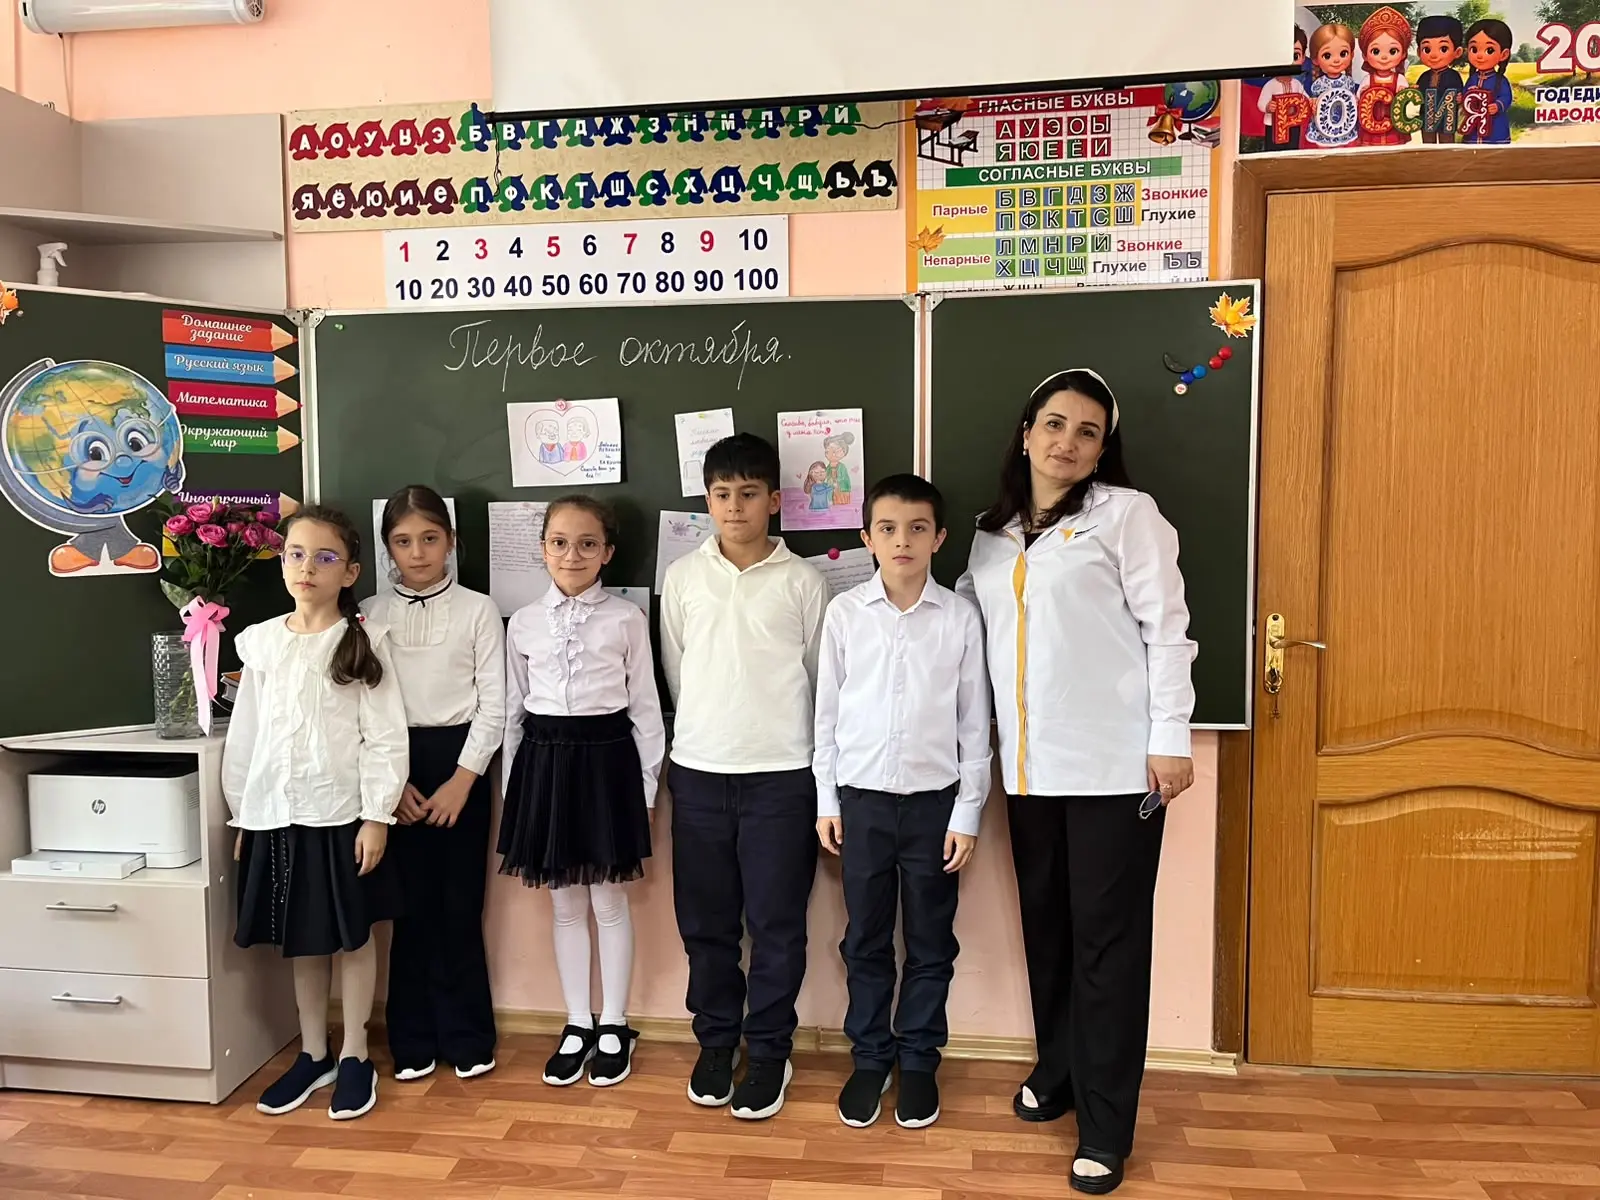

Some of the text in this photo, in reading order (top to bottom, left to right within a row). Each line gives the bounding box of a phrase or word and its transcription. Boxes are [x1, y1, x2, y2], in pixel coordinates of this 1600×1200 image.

[979, 92, 1134, 113] ГЛАСНЫЕ БУКВЫ
[1537, 88, 1569, 103] ГОД
[1271, 87, 1492, 144] РОССИЯ
[999, 115, 1109, 138] А У Э О Ы
[999, 138, 1108, 160] Я Ю Е Ё И
[978, 161, 1151, 182] СОГЛАСНЫЕ БУКВЫ
[1141, 188, 1208, 201] Звонкие
[932, 205, 988, 217] Парные
[1141, 209, 1196, 223] Глухие
[399, 228, 768, 262] 1 2 3 4 5 6 7 8 9 10
[1117, 239, 1183, 252] Звонкие
[924, 254, 991, 267] Непарные
[1093, 261, 1147, 275] Глухие
[395, 268, 779, 300] 10 20 30 40 50 60 70 80 90 100
[181, 314, 252, 332] Домашнее
[190, 329, 244, 343] задание
[444, 319, 792, 392] Первое октября.
[174, 354, 264, 375] Русский язык
[176, 392, 268, 408] Математика
[180, 424, 268, 440] Окружающий
[210, 439, 237, 451] мир
[92, 799, 106, 815] hp
